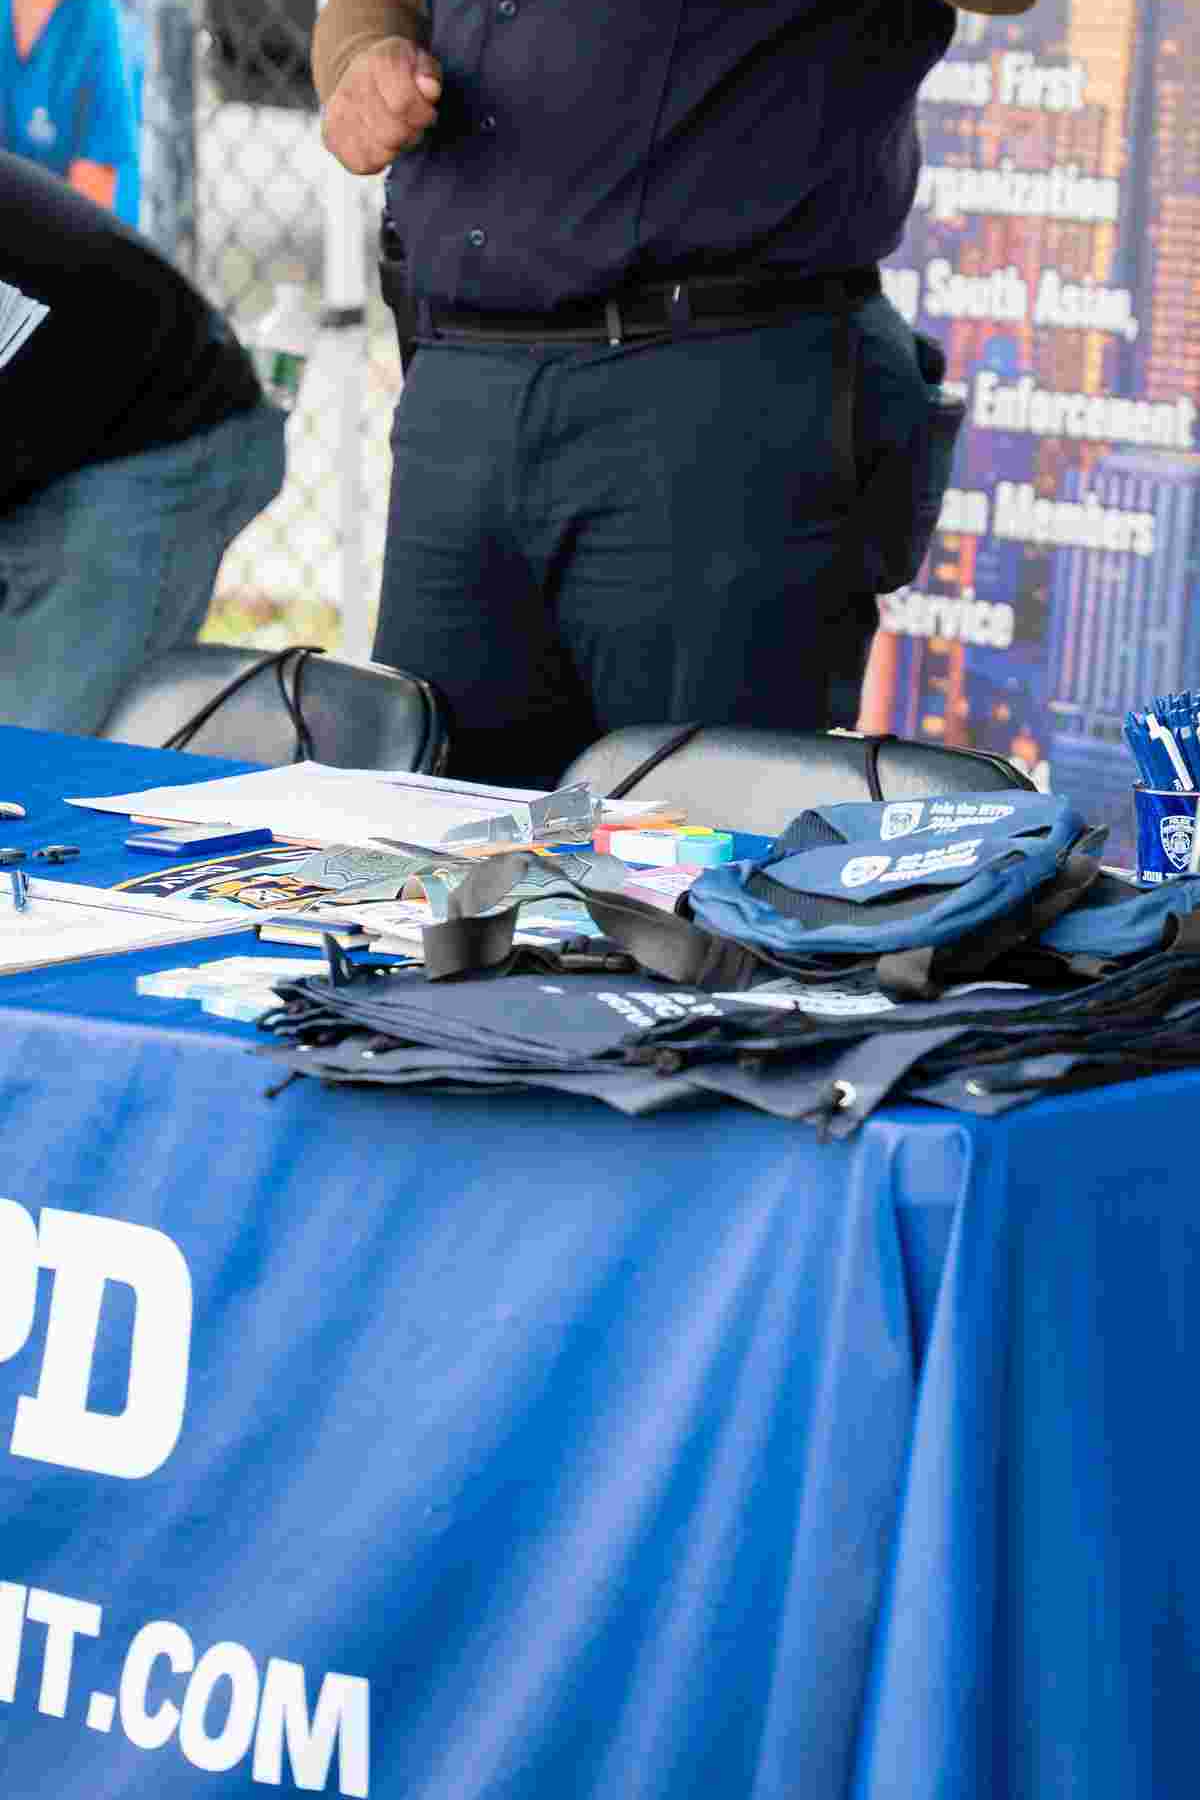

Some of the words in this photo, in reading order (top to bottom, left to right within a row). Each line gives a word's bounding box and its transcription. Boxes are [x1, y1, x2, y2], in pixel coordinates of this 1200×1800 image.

[924, 256, 1028, 318] South
[973, 369, 1198, 447] Enforcement
[992, 479, 1154, 556] Members
